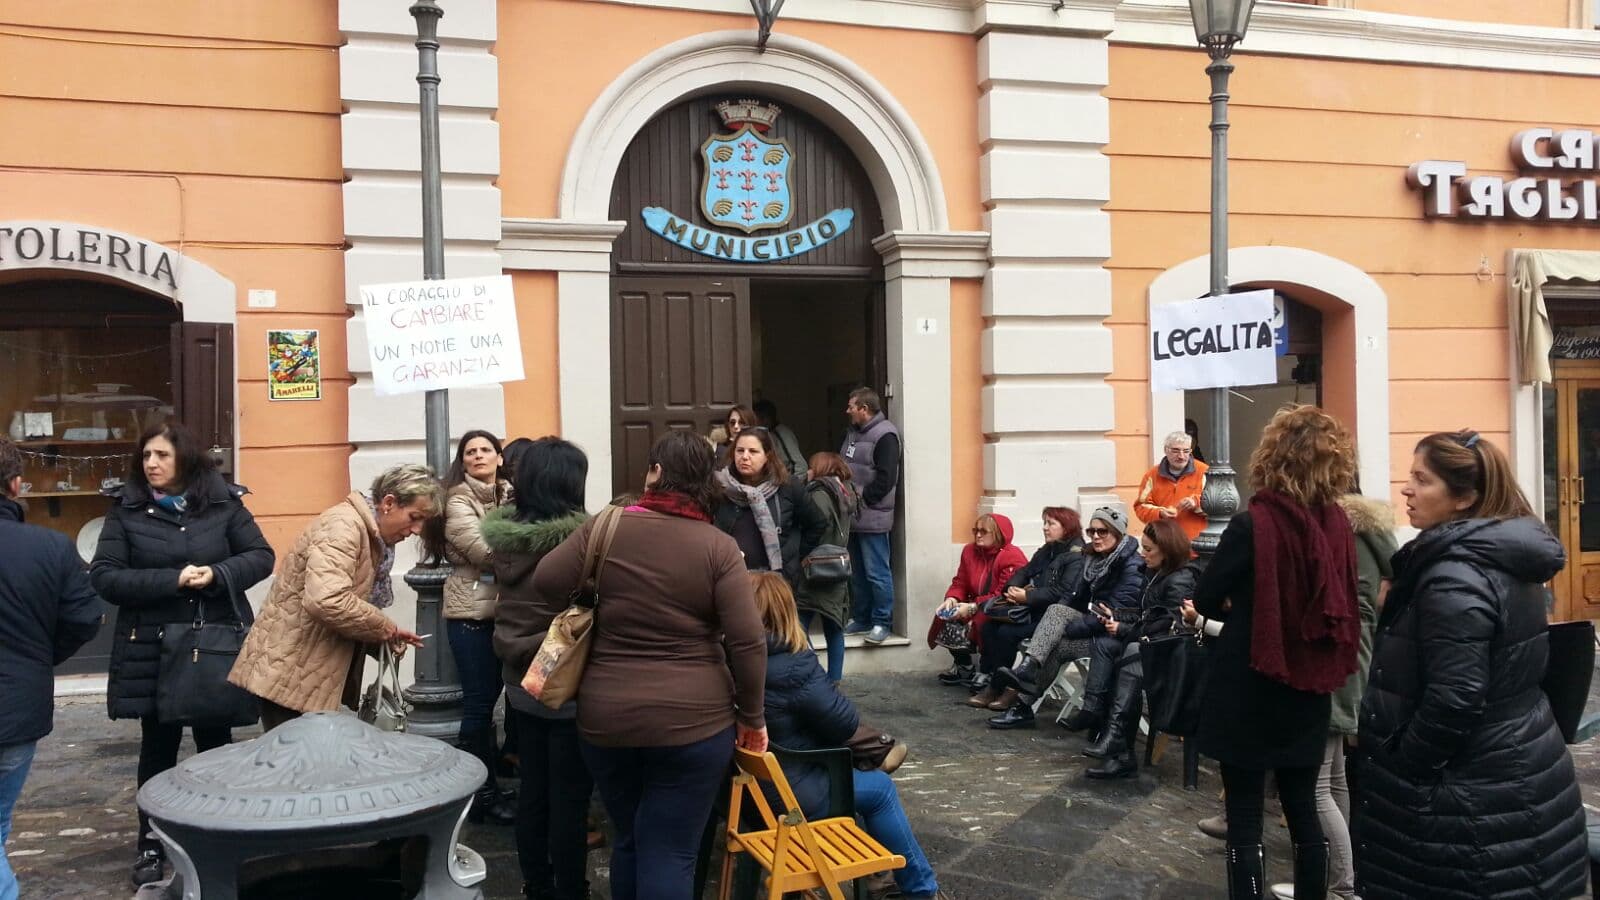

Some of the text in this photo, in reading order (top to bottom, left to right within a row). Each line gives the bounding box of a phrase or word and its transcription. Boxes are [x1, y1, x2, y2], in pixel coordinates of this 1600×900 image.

[1514, 127, 1600, 169] CA
[1410, 160, 1600, 220] TAGLI
[662, 217, 837, 259] MUNICIPIO
[473, 284, 486, 297] DI
[374, 333, 503, 361] UN NOME UNA
[392, 355, 500, 383] GARANZIA
